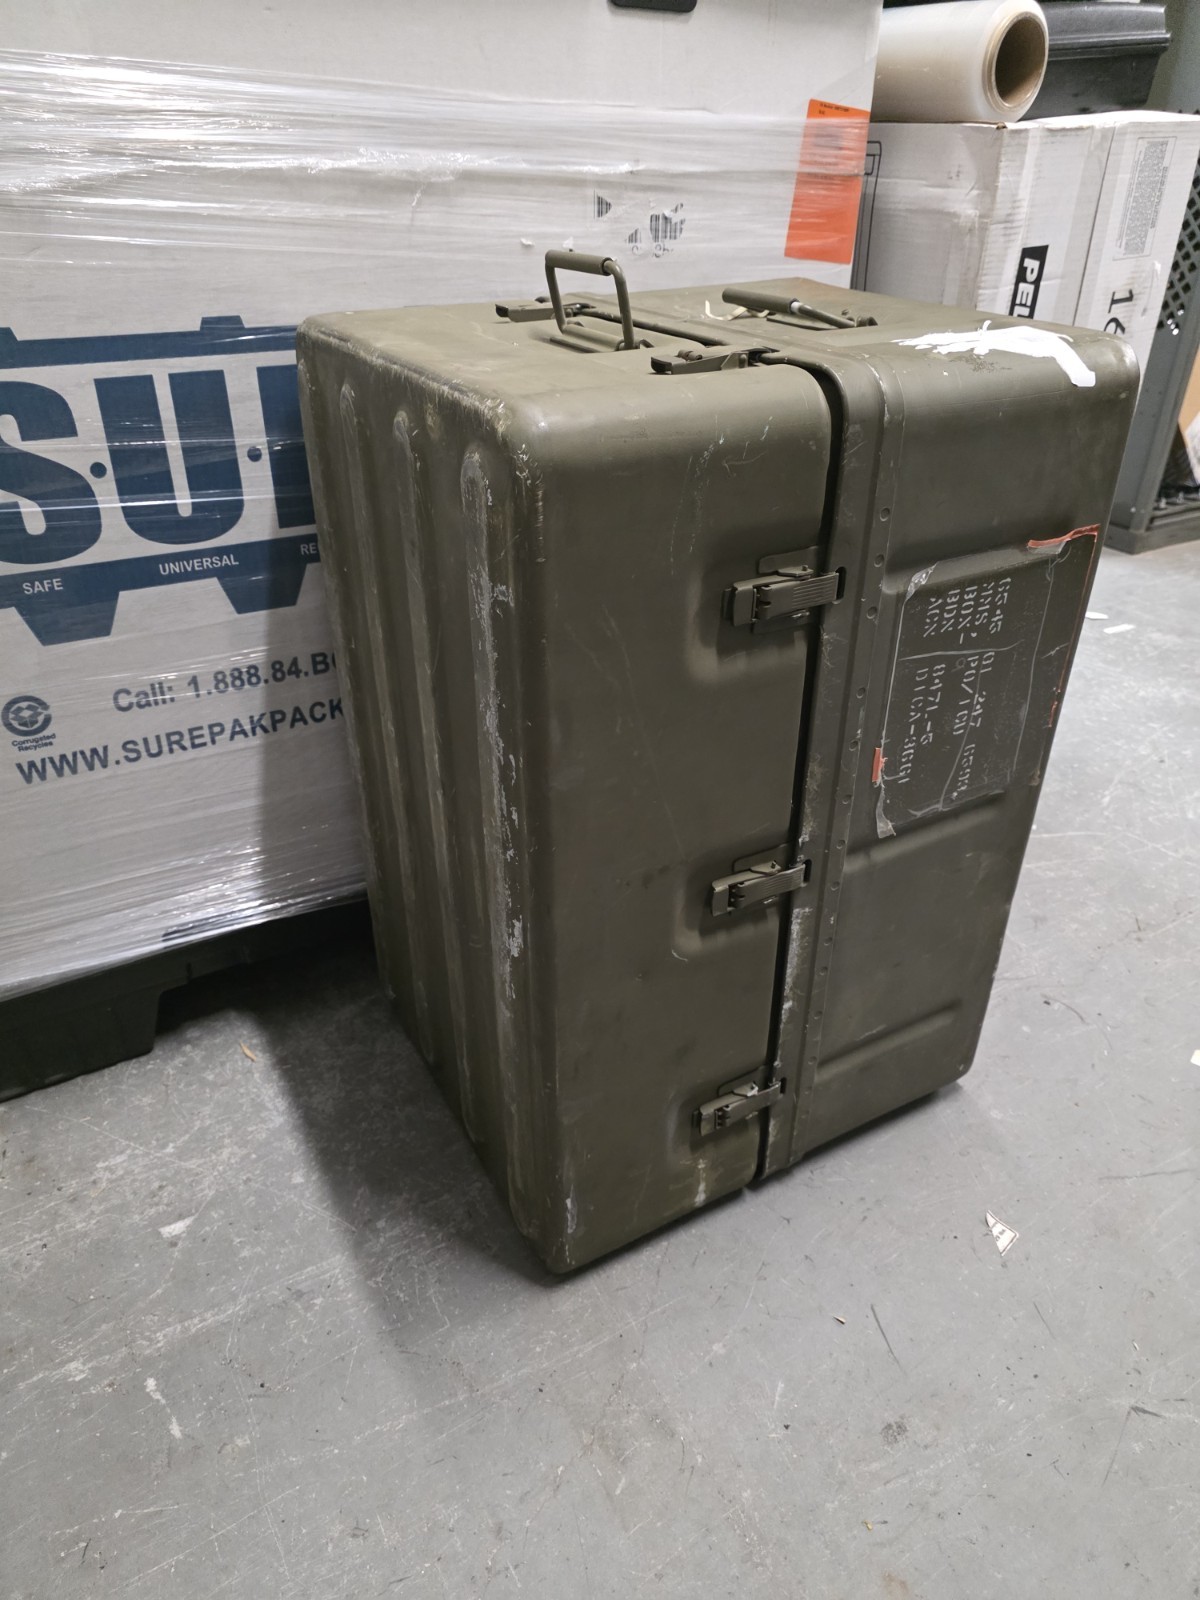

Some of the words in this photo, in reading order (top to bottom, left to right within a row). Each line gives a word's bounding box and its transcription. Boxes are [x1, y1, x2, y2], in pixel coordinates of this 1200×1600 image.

[22, 578, 64, 595] SAFE
[159, 553, 239, 576] UNIVERSAL
[989, 578, 1011, 634] 6545
[980, 652, 995, 673] 01
[113, 681, 176, 713] Call:
[187, 651, 336, 699] 1.888.84.B
[969, 691, 986, 728] 247
[11, 733, 56, 747] Corrugated
[17, 741, 53, 752] Recycles
